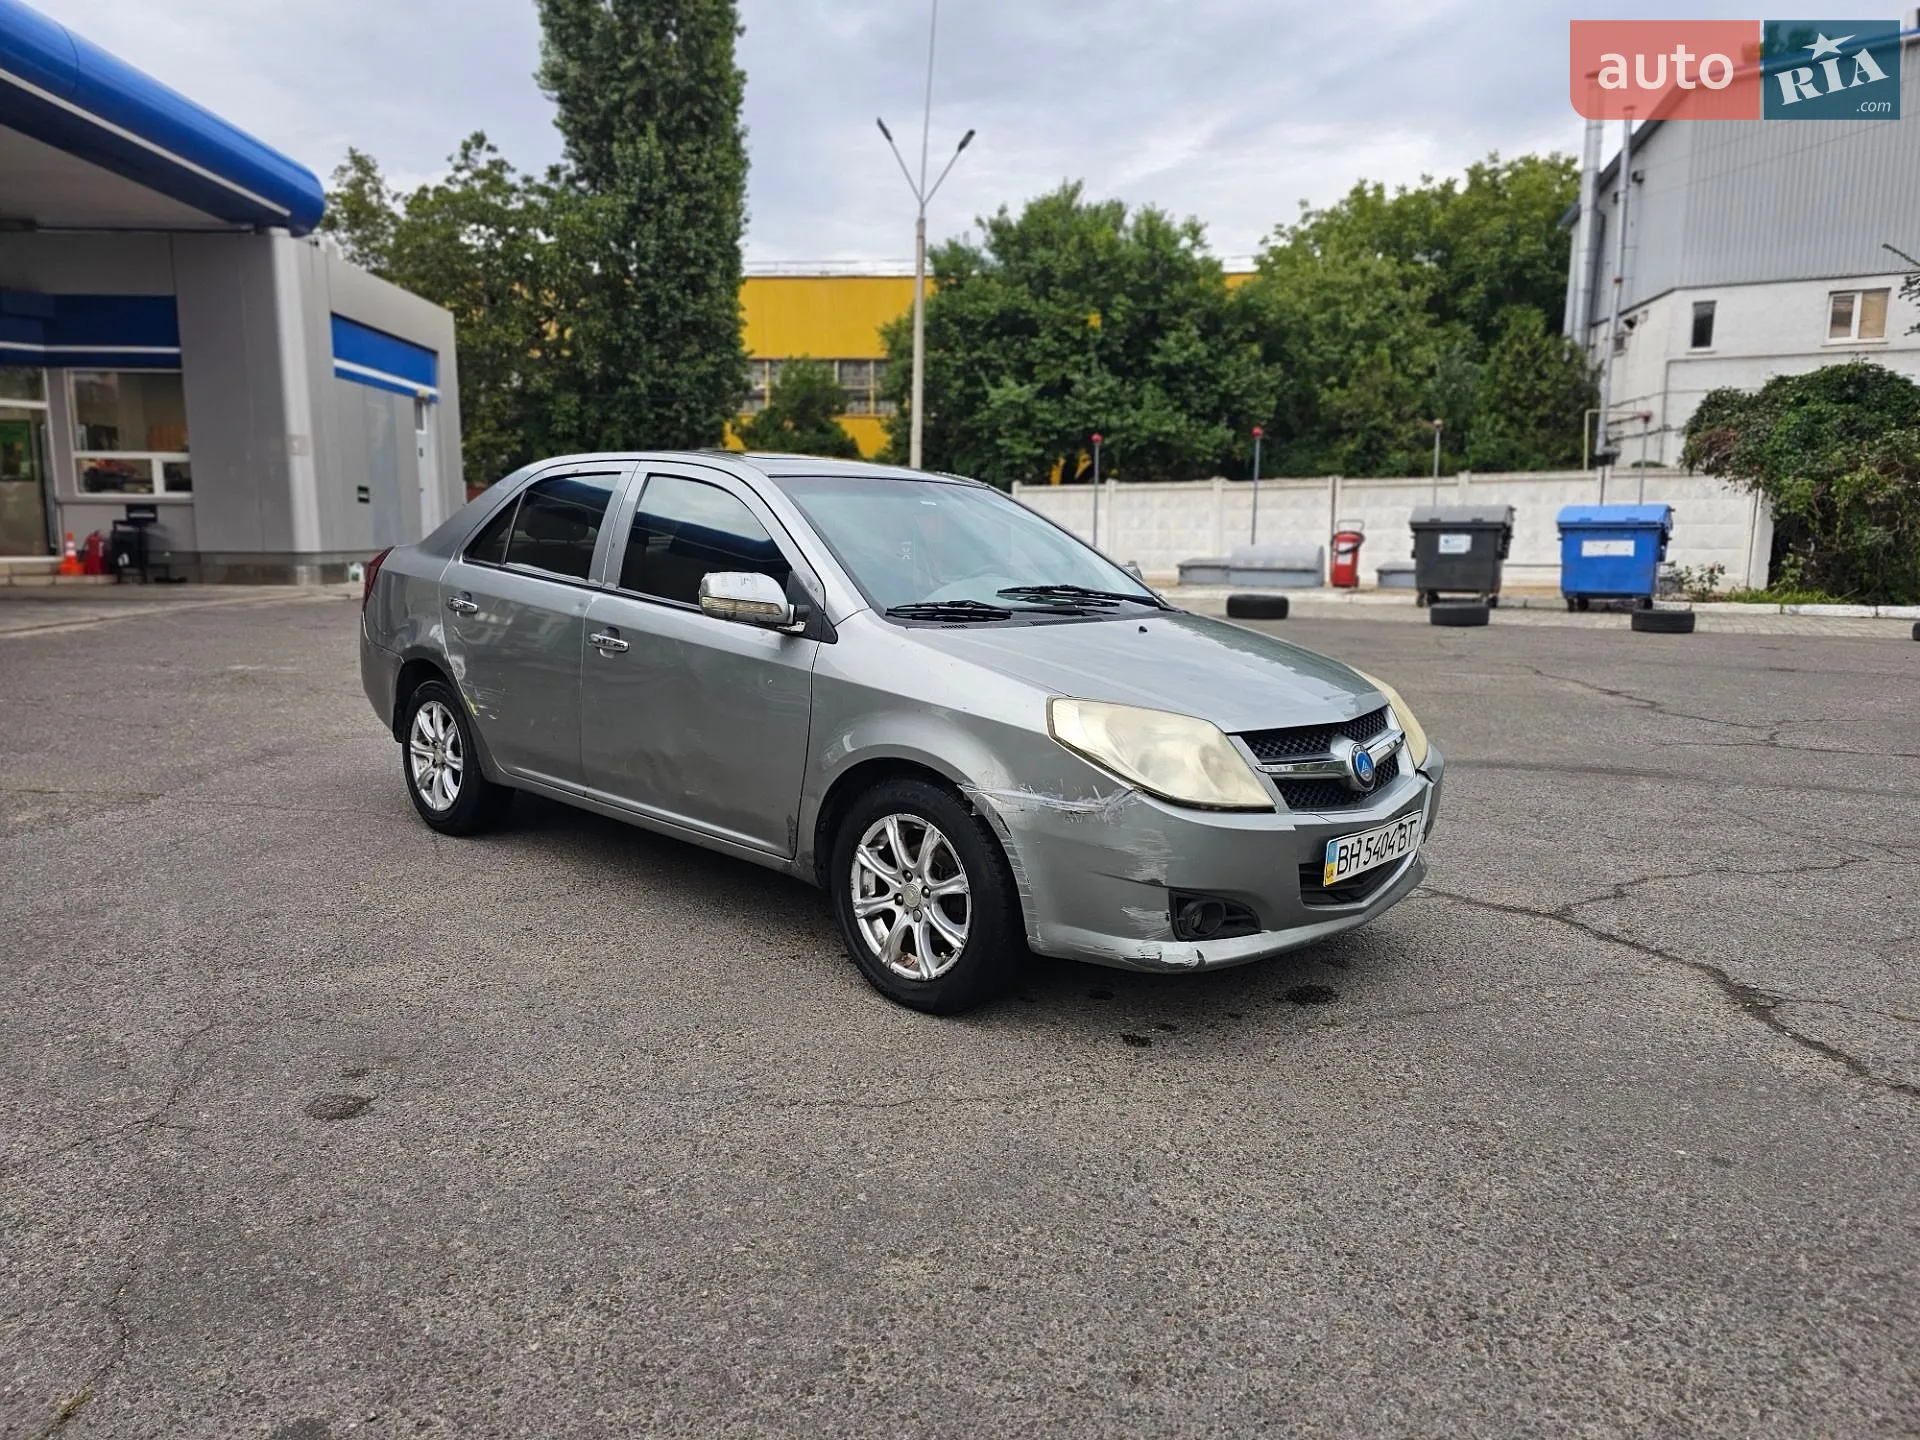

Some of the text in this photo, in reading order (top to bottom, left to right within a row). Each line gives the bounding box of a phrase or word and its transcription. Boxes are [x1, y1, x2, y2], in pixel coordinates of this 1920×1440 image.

[1337, 819, 1417, 875] BH 5404 BT
